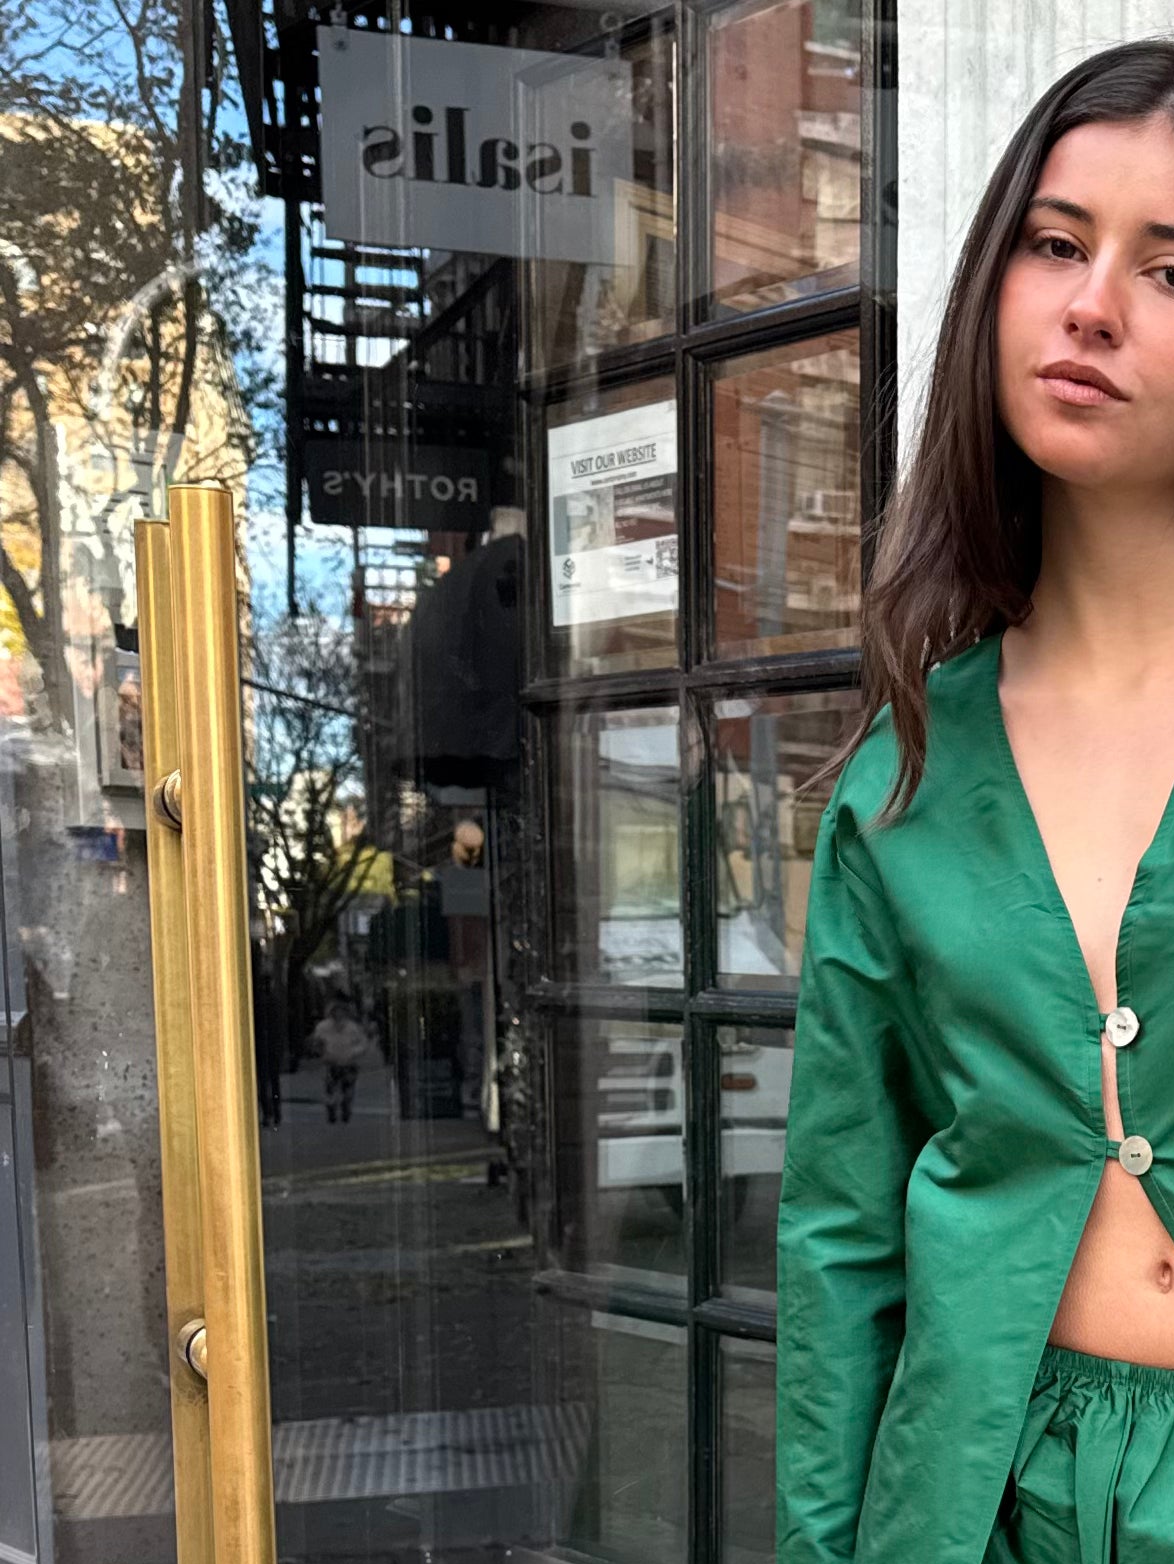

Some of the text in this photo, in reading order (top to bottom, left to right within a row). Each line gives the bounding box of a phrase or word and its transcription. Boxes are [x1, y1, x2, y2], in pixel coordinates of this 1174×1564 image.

[570, 442, 657, 476] VISIT OUR WEBSITE
